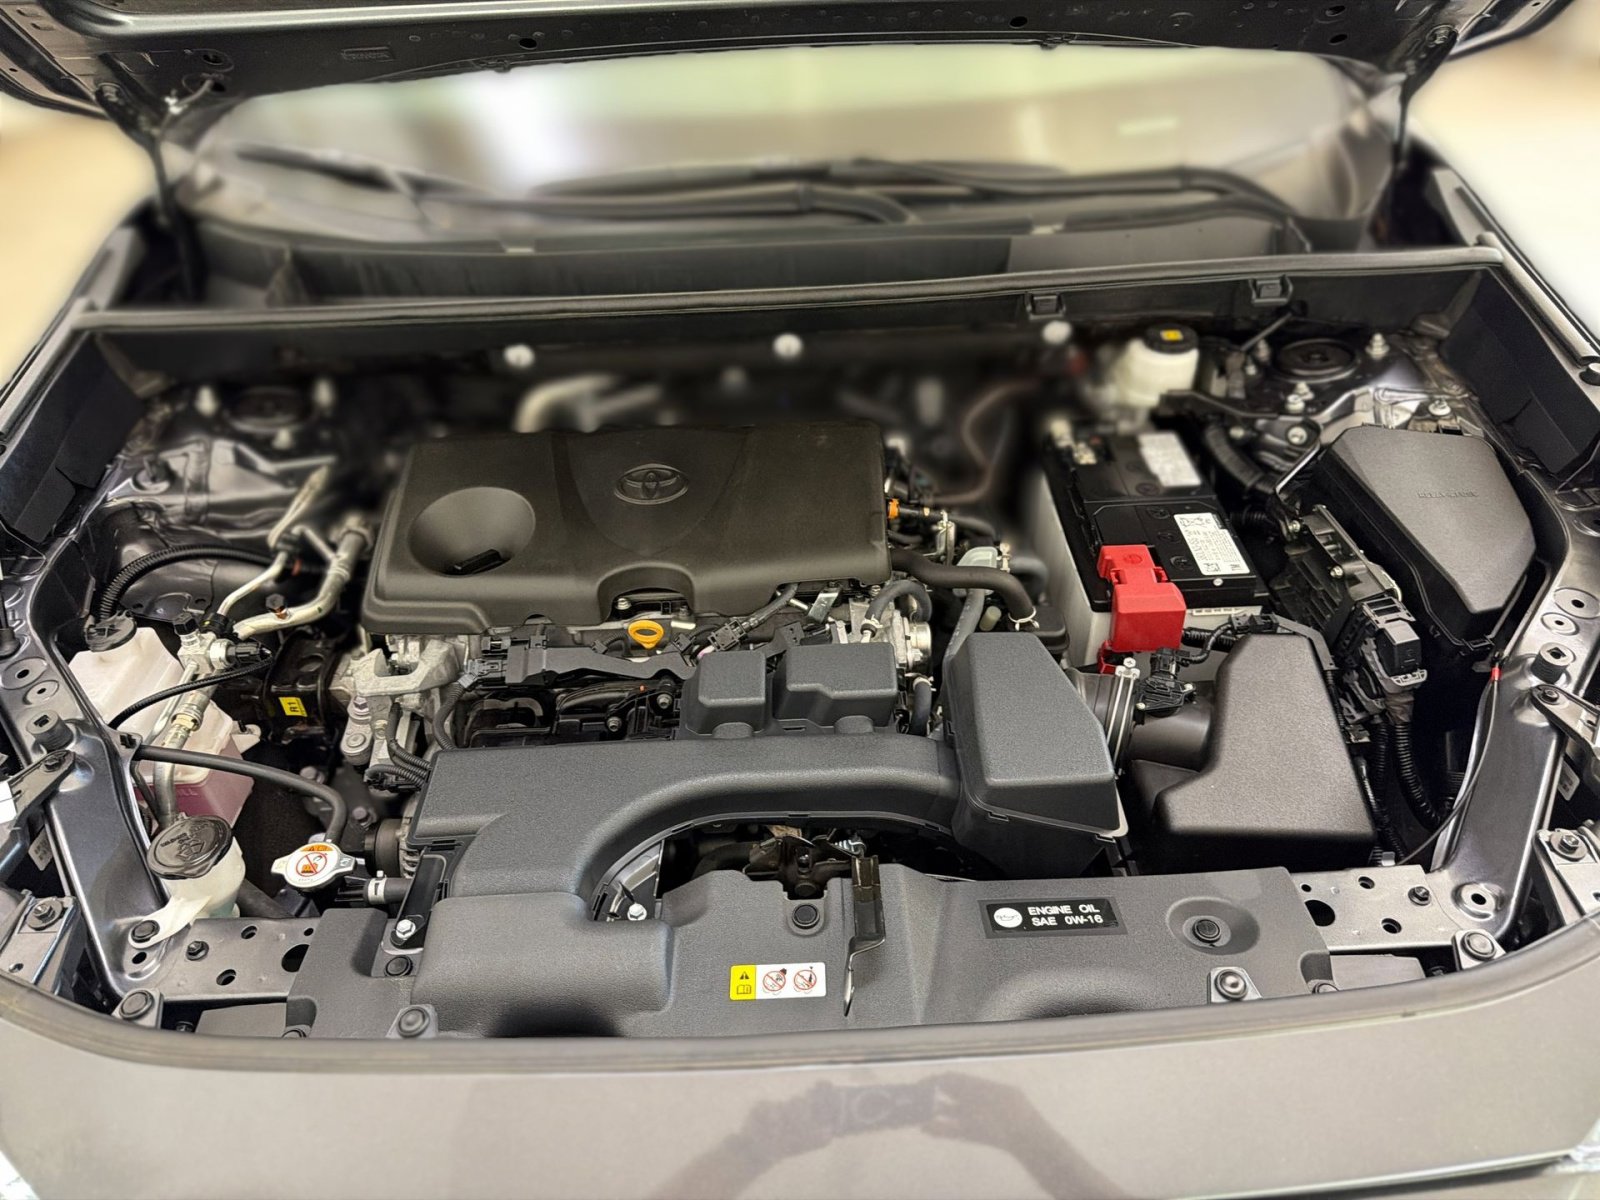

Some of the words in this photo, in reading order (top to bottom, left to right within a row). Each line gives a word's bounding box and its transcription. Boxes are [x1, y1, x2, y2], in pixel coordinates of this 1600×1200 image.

[1027, 905, 1072, 916] ENGINE
[1078, 904, 1100, 914] OIL
[1031, 917, 1058, 927] SAE
[1064, 915, 1103, 926] 0W-16
